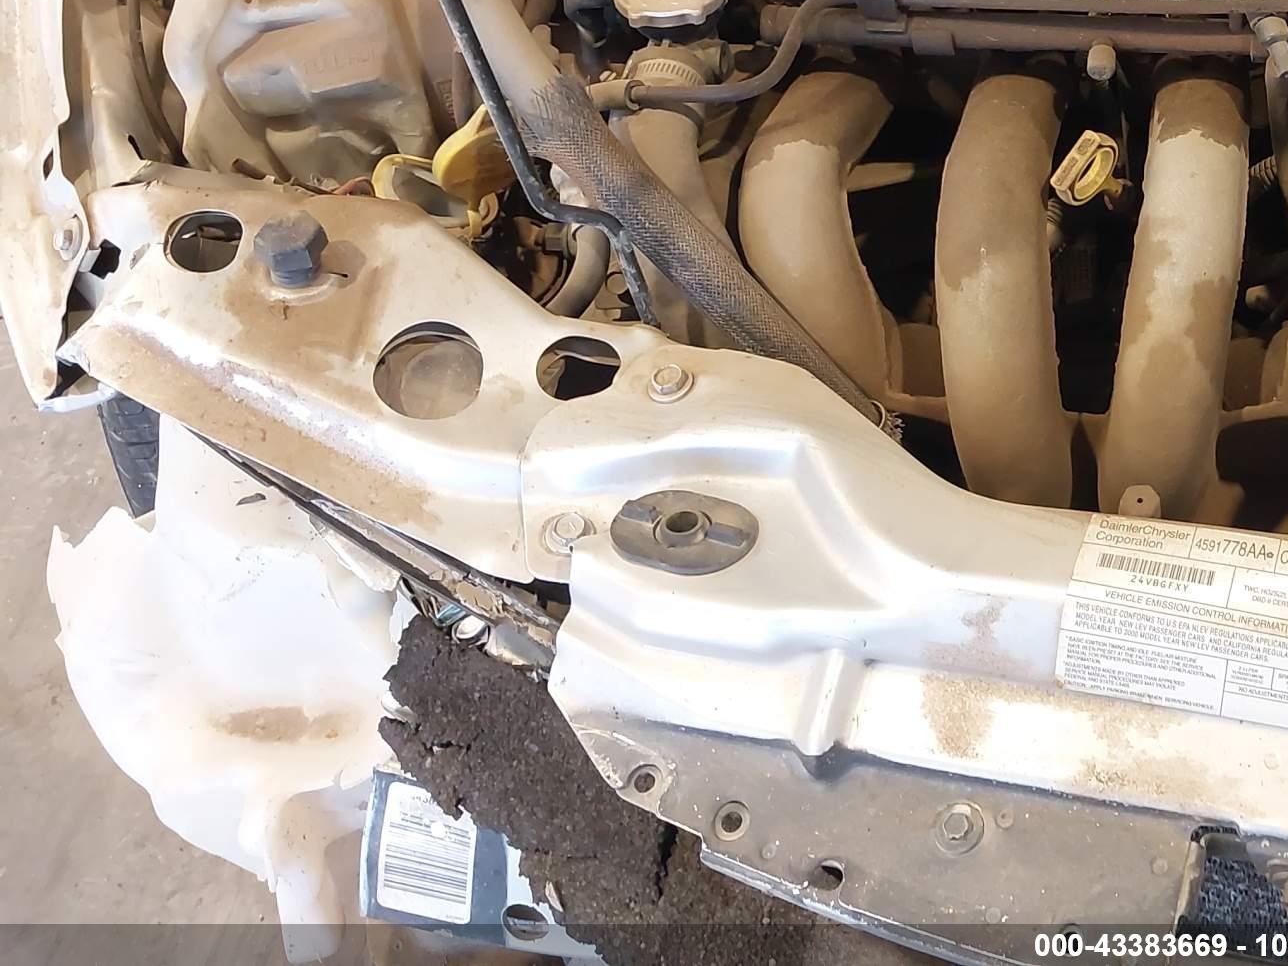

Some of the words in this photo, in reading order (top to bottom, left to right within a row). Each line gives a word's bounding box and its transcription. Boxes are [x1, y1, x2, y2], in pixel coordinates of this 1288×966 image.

[1096, 531, 1163, 549] Corporation
[1100, 520, 1190, 540] DaimlerChrysler
[1131, 575, 1188, 590] 24VBGFXY
[1104, 590, 1144, 602] VEHICLE
[1145, 598, 1190, 612] EMISSION
[1192, 607, 1236, 620] CONTROL
[1075, 602, 1090, 610] THIS
[1091, 605, 1118, 616] VEHICLE
[1118, 611, 1155, 623] CONFORMS
[1156, 618, 1165, 626] TO
[1178, 622, 1190, 630] EPA
[1210, 629, 1254, 642] REGULATIONS
[1076, 612, 1097, 620] MODEL
[1119, 620, 1134, 628] NEW
[1134, 623, 1147, 631] LEV
[1148, 626, 1186, 637] PASSENGER
[1208, 637, 1221, 645] AND
[1223, 640, 1261, 652] CALIFORNIA
[1074, 620, 1112, 632] APPLICABLE
[1113, 627, 1123, 635] TO
[1139, 632, 1162, 641] MODEL
[1163, 637, 1180, 645] YEAR
[1181, 640, 1196, 648] NEW
[1197, 643, 1209, 651] LEV
[1211, 646, 1249, 657] PASSENGER
